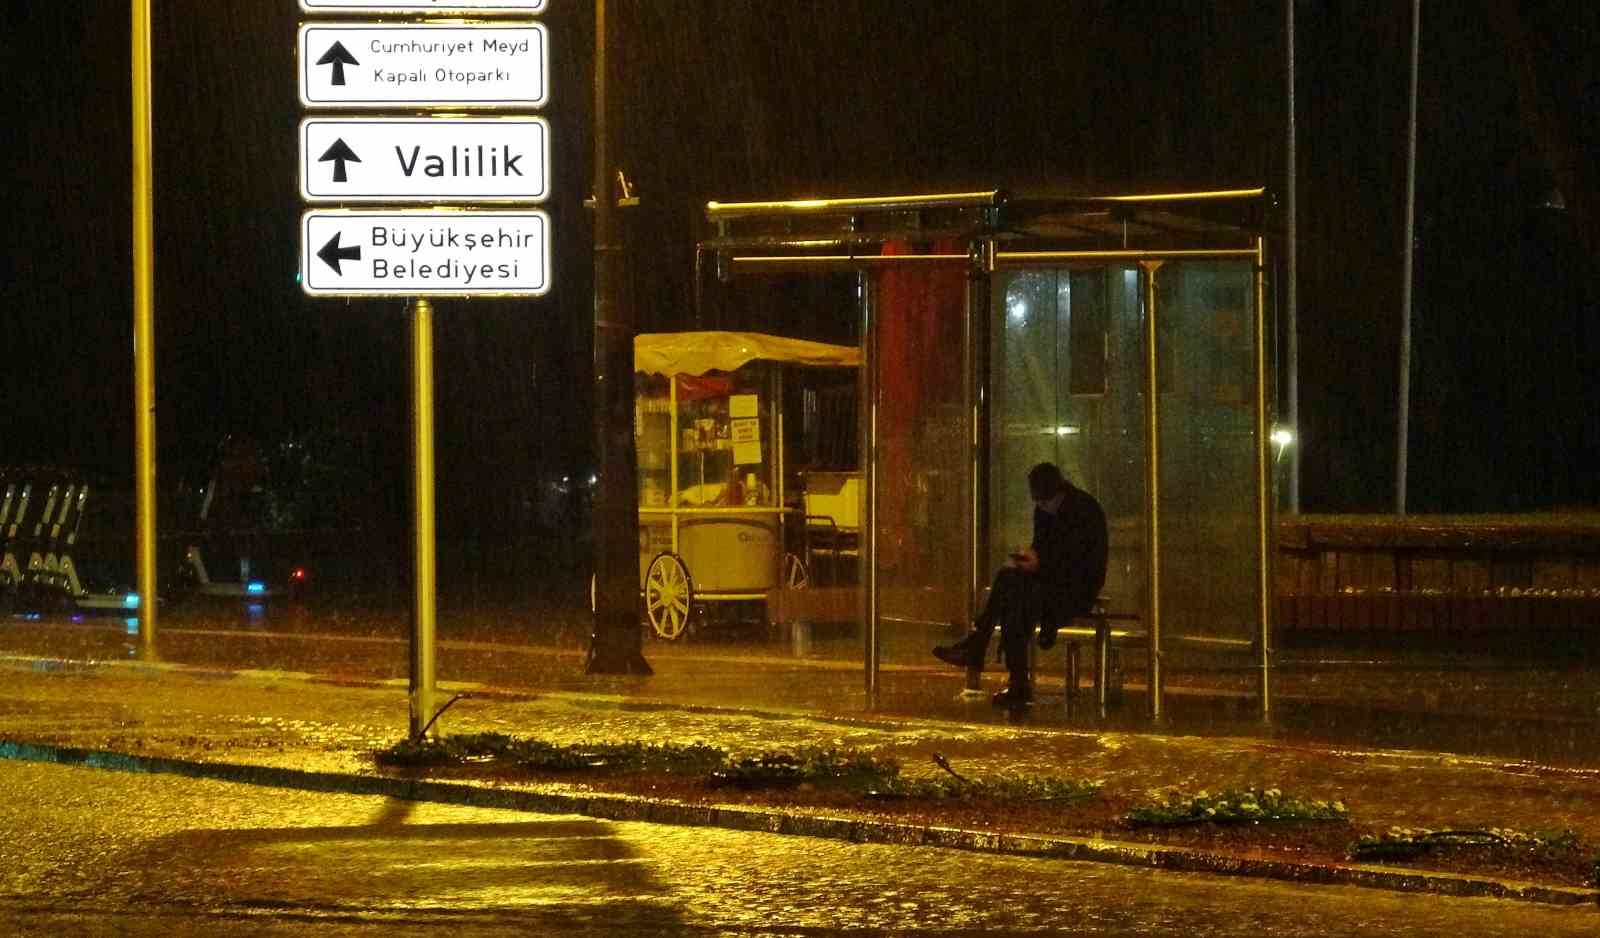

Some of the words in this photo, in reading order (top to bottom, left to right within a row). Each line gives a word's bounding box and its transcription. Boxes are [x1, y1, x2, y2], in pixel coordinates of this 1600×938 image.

[483, 40, 529, 56] Meyd
[374, 67, 426, 86] Kapalı
[435, 67, 510, 86] Otoparkı
[396, 145, 523, 178] Valilik
[372, 226, 534, 253] Büyükşehir
[373, 258, 519, 285] Belediyesi
